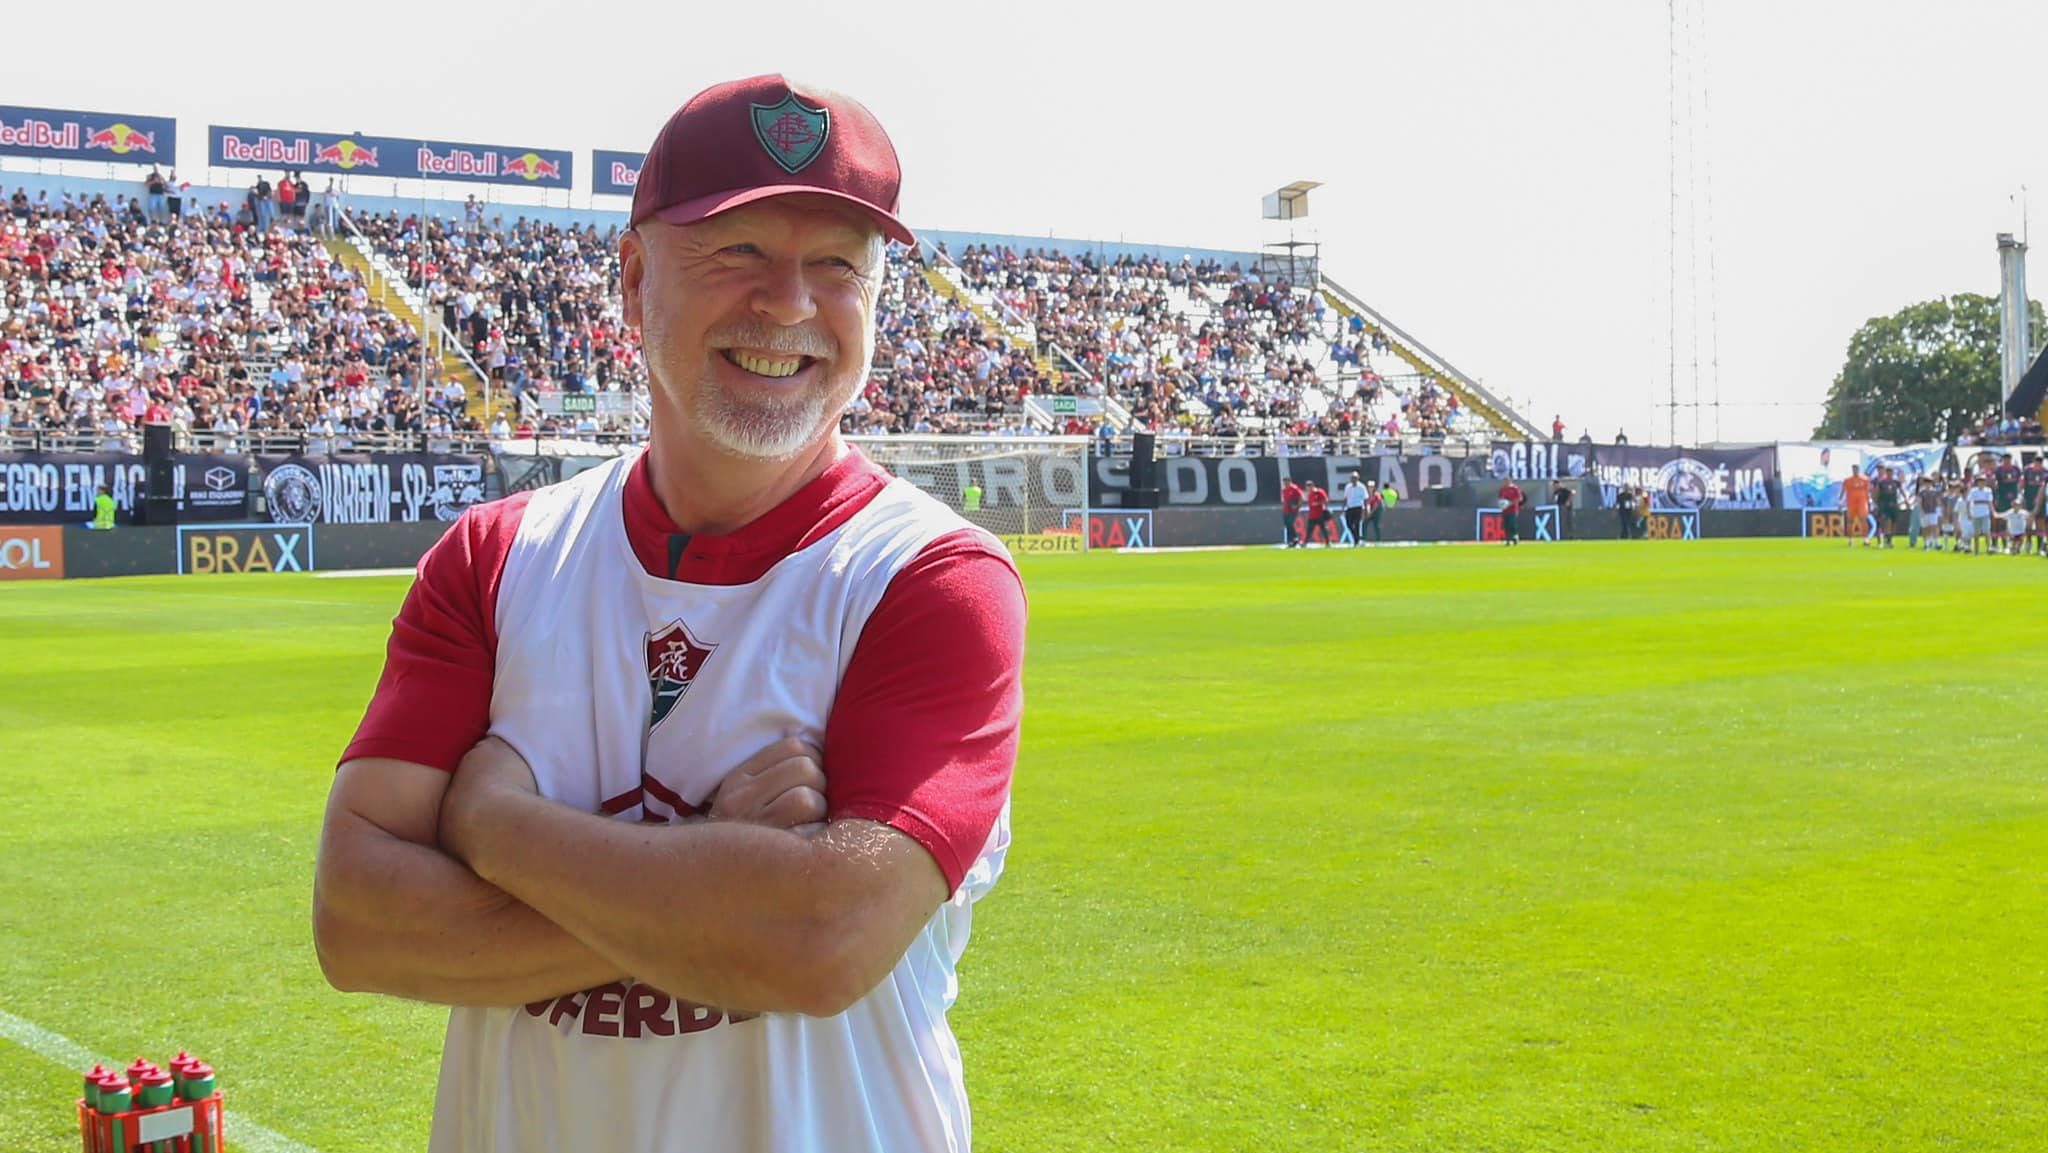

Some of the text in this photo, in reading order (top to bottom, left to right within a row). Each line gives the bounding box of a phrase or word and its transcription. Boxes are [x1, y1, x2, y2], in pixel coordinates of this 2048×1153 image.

[0, 119, 79, 149] ed Bull
[223, 135, 309, 165] Red Bull
[417, 148, 497, 176] Red Bull
[611, 161, 641, 185] Re
[64, 463, 105, 511] EM
[1167, 458, 1258, 504] DO
[1483, 513, 1552, 542] BRX
[1648, 516, 1695, 541] BRAX
[0, 538, 51, 569] OL
[190, 534, 301, 573] BRAX
